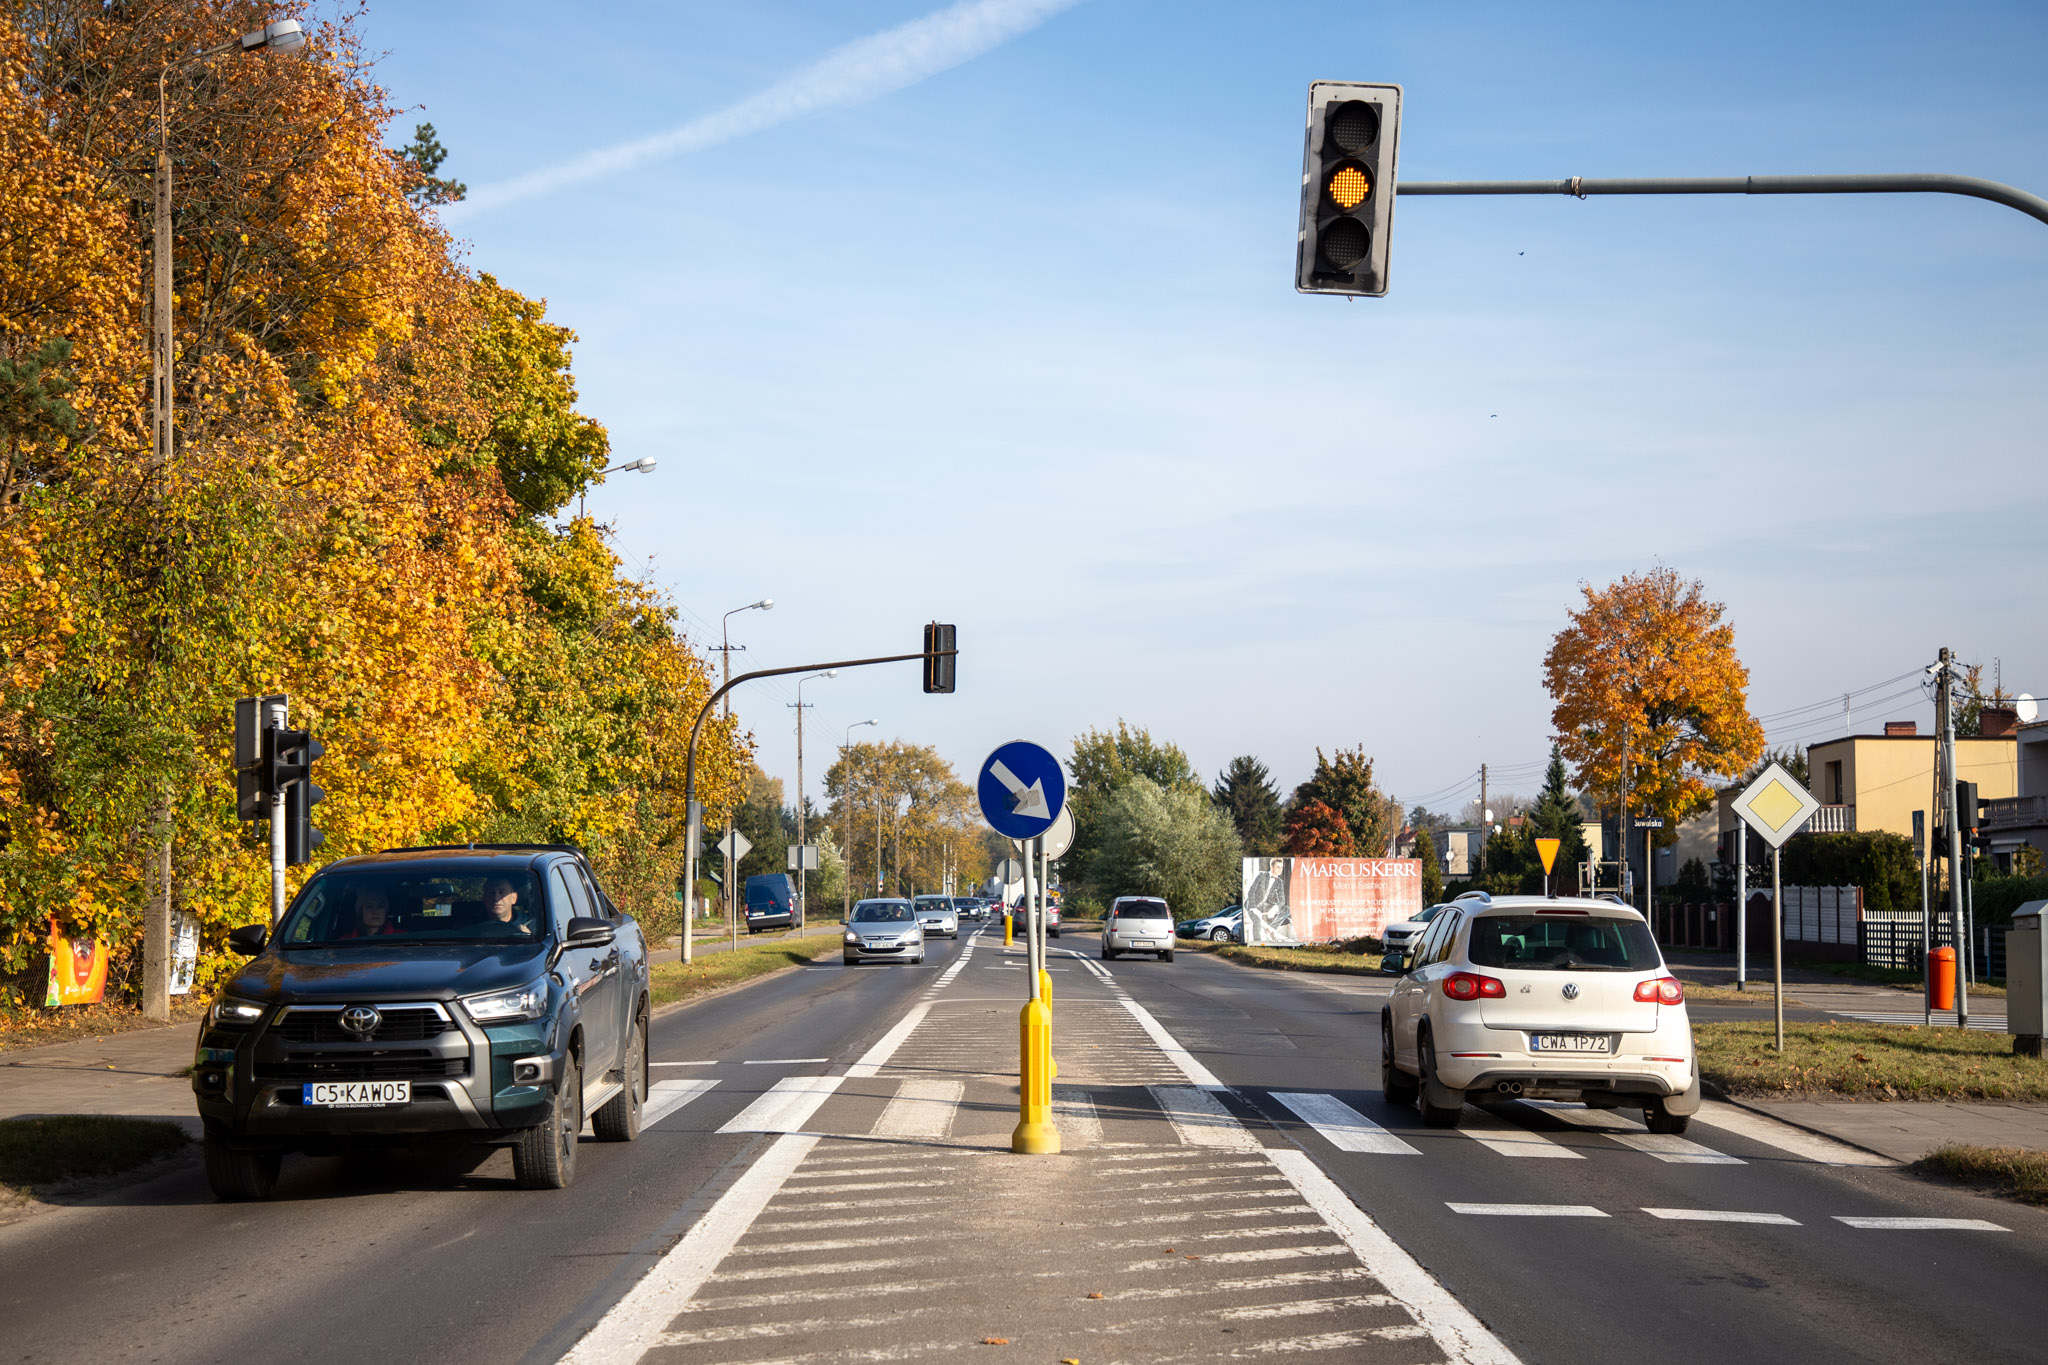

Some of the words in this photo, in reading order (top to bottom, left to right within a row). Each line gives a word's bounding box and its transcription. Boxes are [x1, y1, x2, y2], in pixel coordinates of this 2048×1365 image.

[1634, 819, 1662, 827] Suwalska
[1332, 881, 1356, 890] Men's
[1357, 881, 1388, 890] Fashion
[1541, 1036, 1567, 1049] CWA
[1573, 1036, 1605, 1050] 1P72
[316, 1085, 338, 1102] C5
